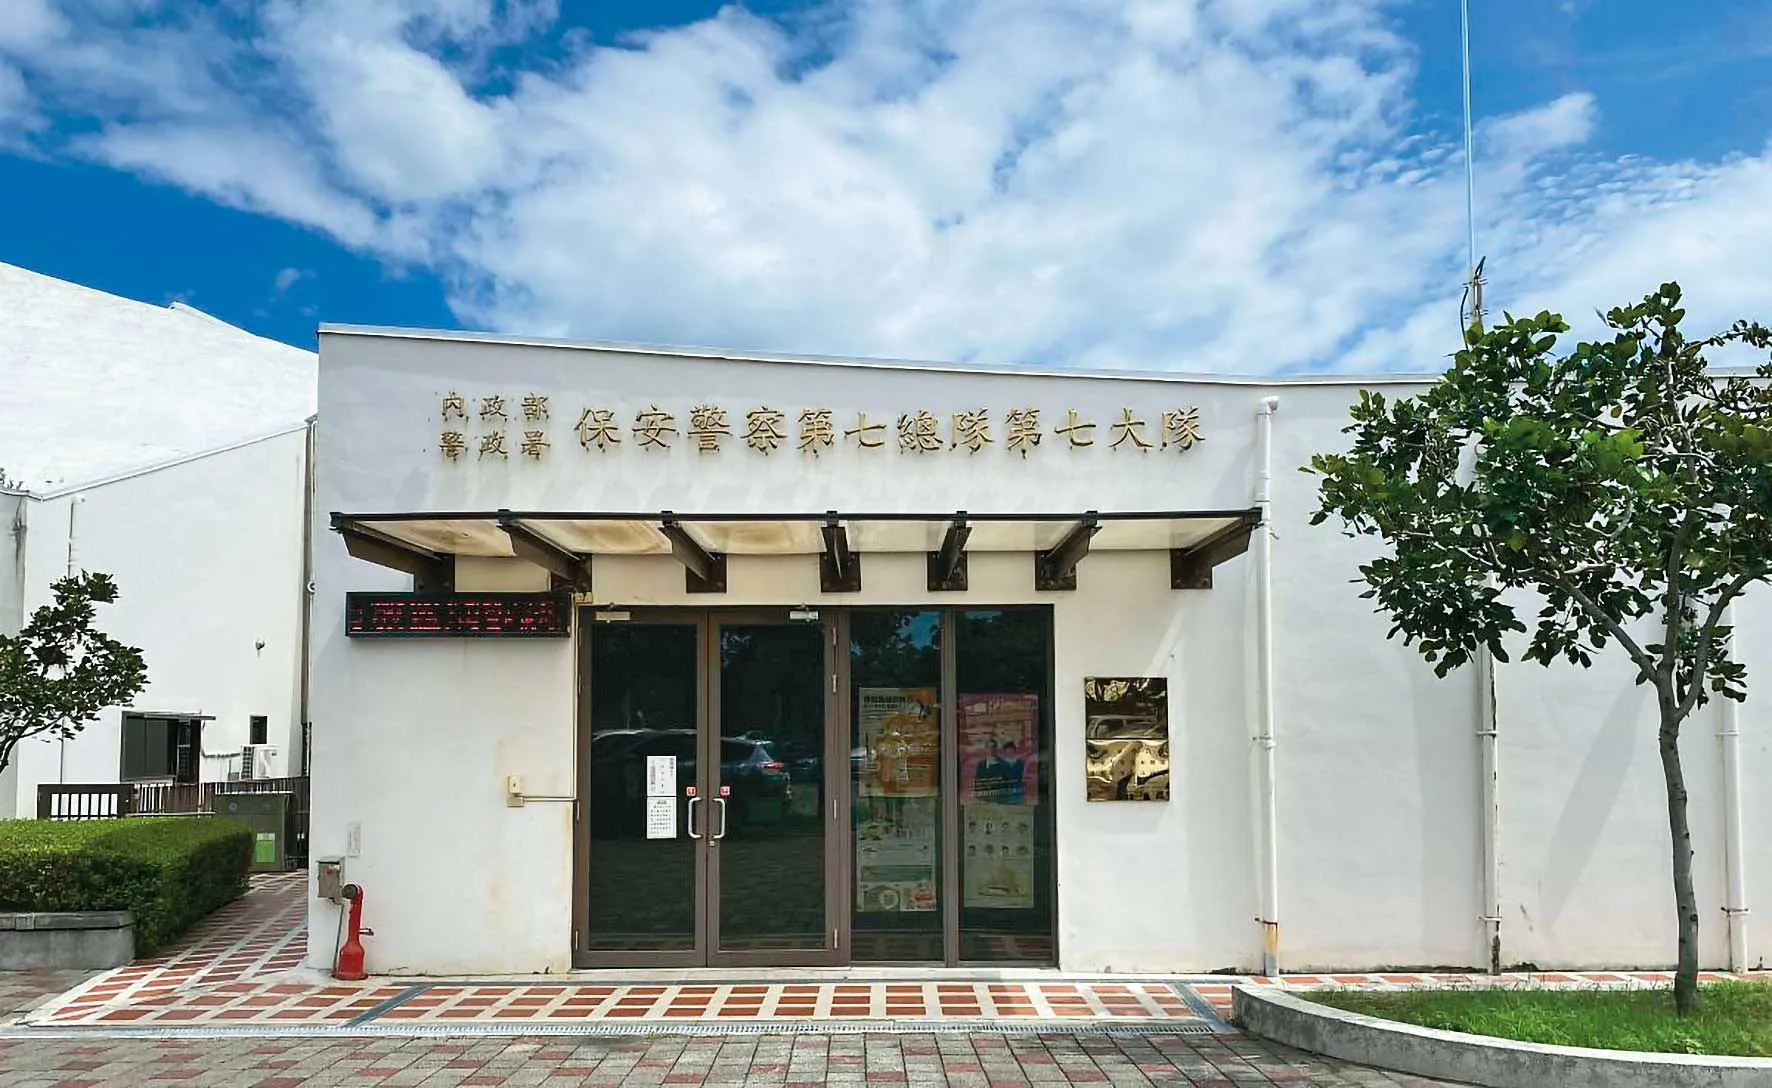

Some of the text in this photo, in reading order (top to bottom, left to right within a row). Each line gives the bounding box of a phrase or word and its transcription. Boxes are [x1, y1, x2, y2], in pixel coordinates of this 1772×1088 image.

[439, 431, 550, 459] 警政署
[574, 405, 1205, 457] 保安警察第七總隊第七大隊
